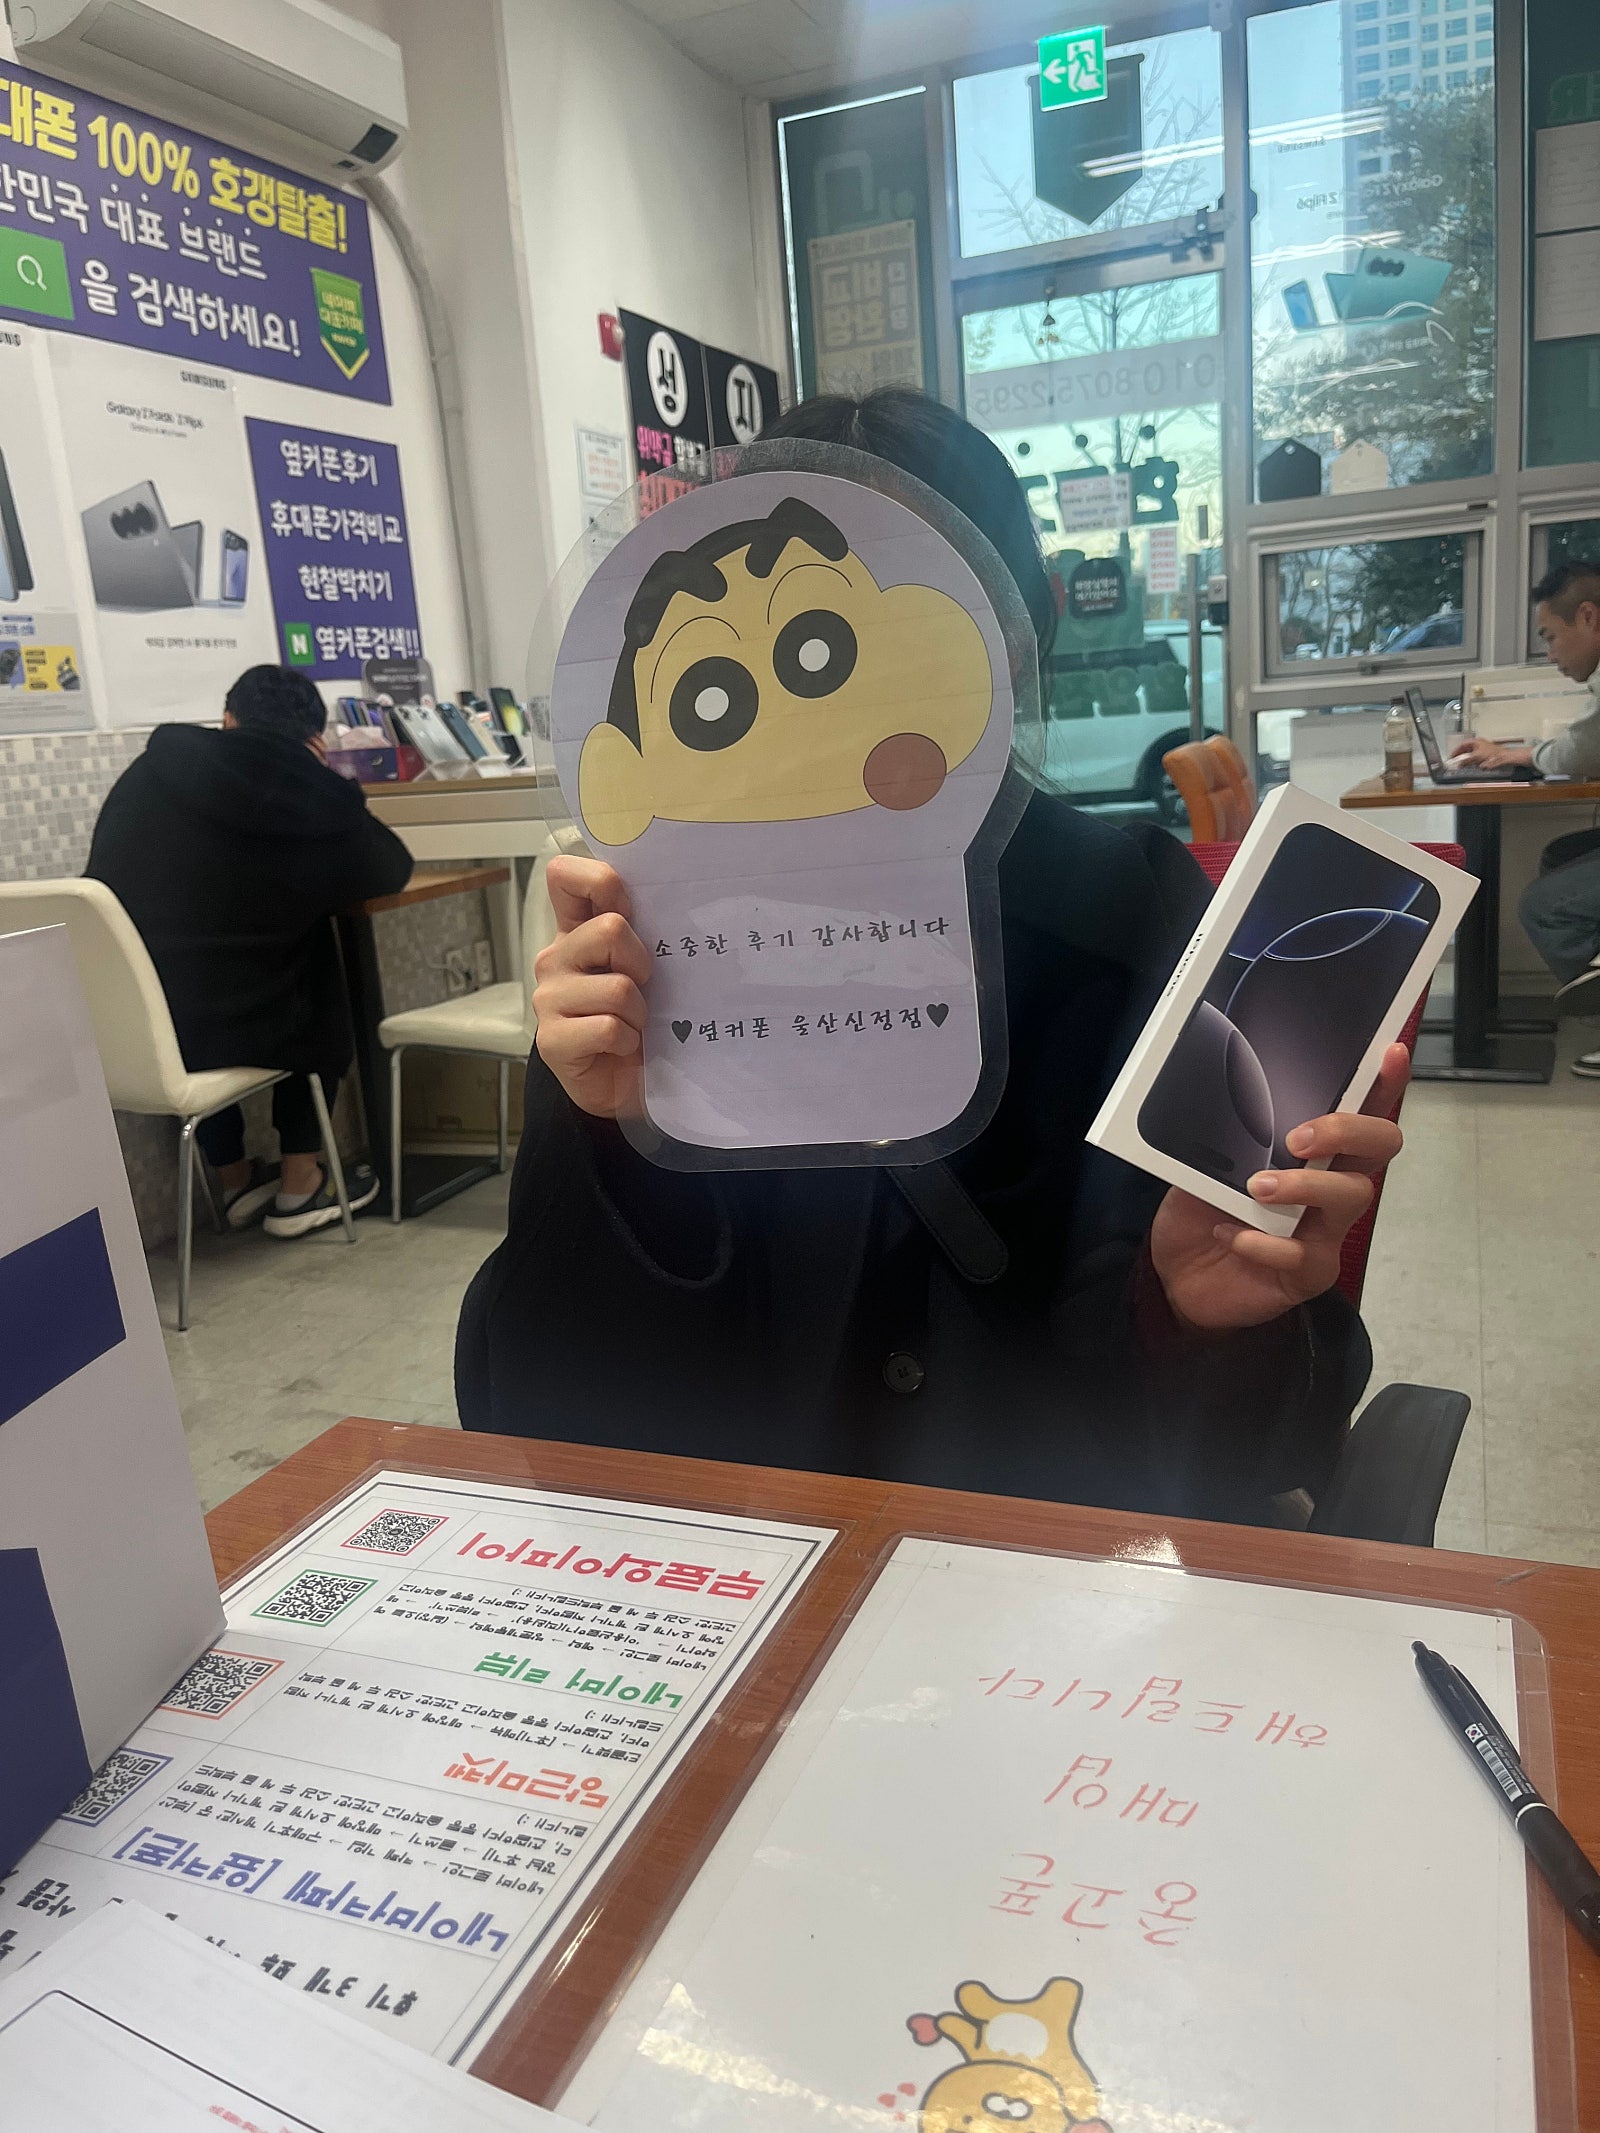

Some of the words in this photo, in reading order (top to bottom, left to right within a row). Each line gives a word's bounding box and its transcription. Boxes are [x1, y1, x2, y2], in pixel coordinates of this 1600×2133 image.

[0, 77, 78, 161] 대폰
[88, 115, 201, 199] 100%
[208, 156, 348, 254] 호갱탈출!
[100, 197, 169, 251] 대표
[178, 216, 268, 280] 브랜드
[80, 259, 119, 316] 을
[127, 272, 301, 358] 검색하세요!
[279, 438, 379, 487] 옆커폰후기
[270, 500, 404, 545] 휴대폰가격비교
[298, 563, 394, 602] 현찰박치기
[315, 626, 421, 661] 옆커폰검색!!
[655, 933, 729, 958] 소중한
[747, 929, 795, 952] 후기
[812, 916, 950, 947] 감사합니다
[698, 1016, 771, 1043] 옆커폰
[791, 1006, 923, 1037] 울산신정점
[457, 1532, 766, 1601] 무료와이파이
[474, 1652, 551, 1685] 리뷰
[565, 1670, 681, 1708] 네이버
[444, 1753, 608, 1809] 당근마켓
[1043, 1753, 1200, 1828] 매입
[113, 1826, 283, 1895] [옆커폰]
[283, 1870, 510, 1954] 네이버카페
[987, 1852, 1199, 1947] 중고폰
[303, 1966, 359, 1999] 3개
[365, 1983, 419, 2017] 후기
